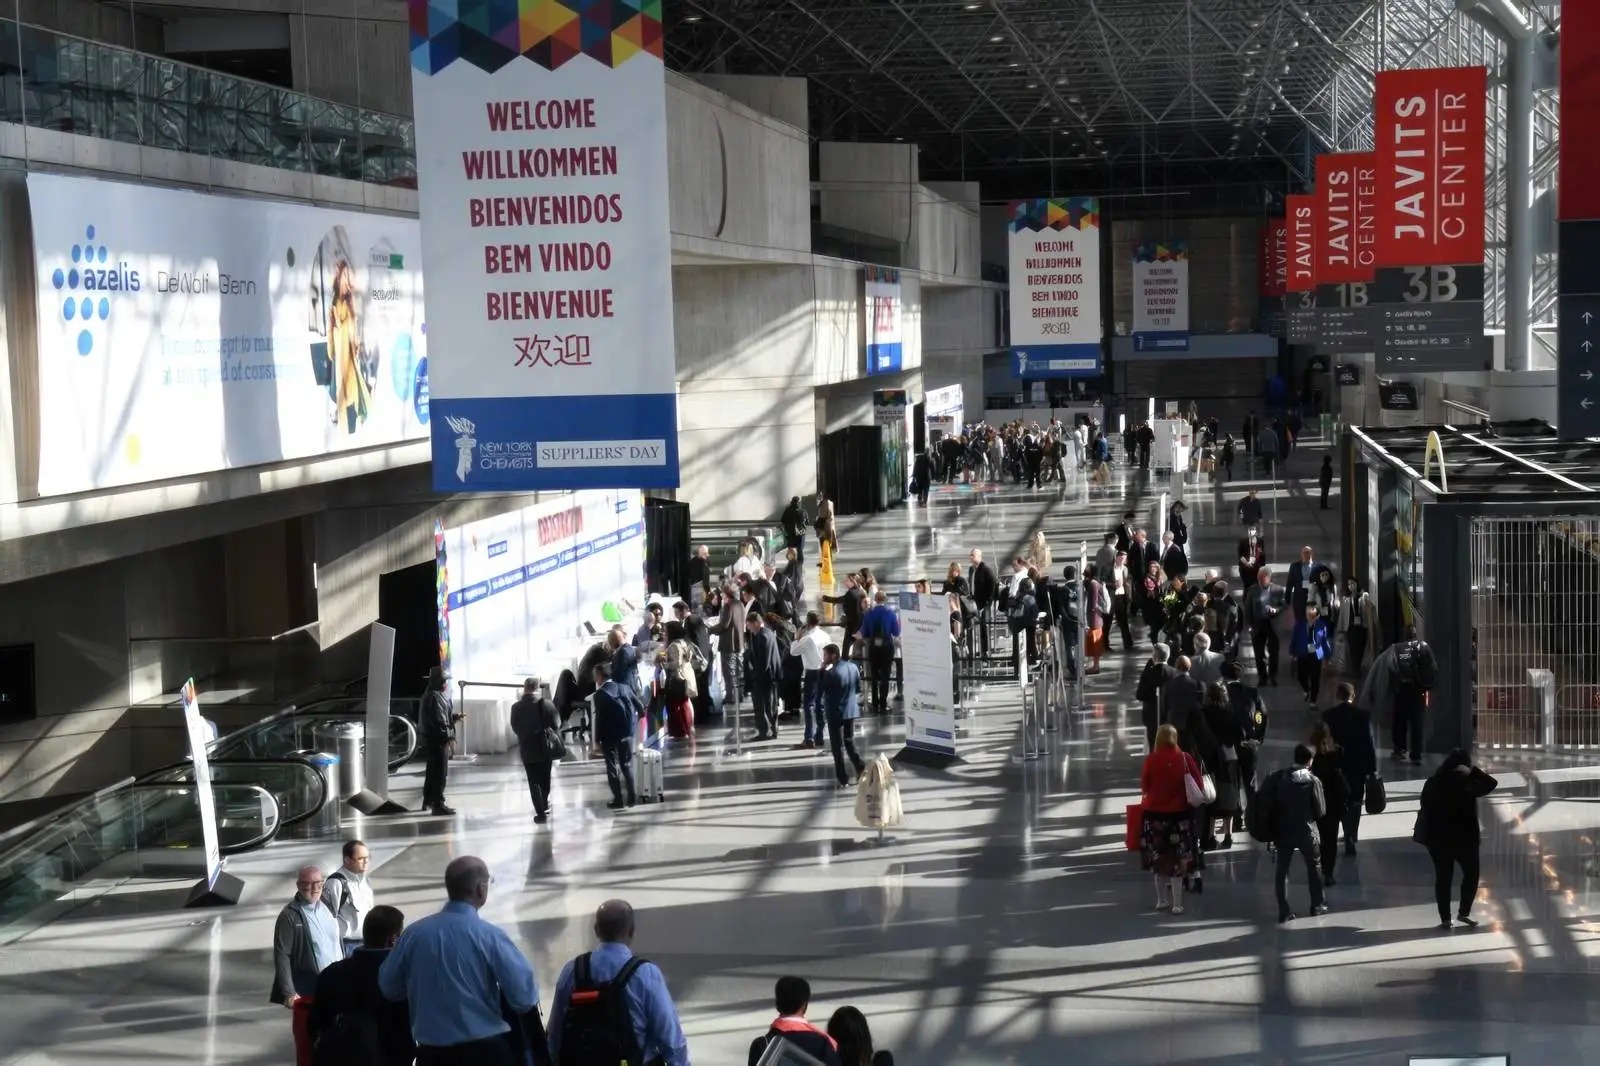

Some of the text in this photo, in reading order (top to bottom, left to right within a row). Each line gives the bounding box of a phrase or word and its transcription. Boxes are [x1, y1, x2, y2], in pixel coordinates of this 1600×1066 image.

[486, 98, 596, 132] WELCOME
[462, 146, 618, 180] WILLKOMMEN
[1395, 96, 1426, 239] JAVITS
[1441, 92, 1466, 238] CENTER
[470, 193, 623, 227] BIENVENIDOS
[1328, 170, 1349, 265] JAVITS
[1358, 168, 1376, 264] CENTER
[485, 242, 612, 274] BEM VINDO
[1296, 207, 1312, 278] JAVITS
[84, 262, 140, 292] azelis
[1402, 266, 1458, 302] 3B
[486, 289, 614, 320] BIENVENUE
[1336, 282, 1368, 307] 1B
[513, 334, 592, 368] 欢迎
[480, 442, 503, 453] NEW
[630, 446, 660, 459] DAY
